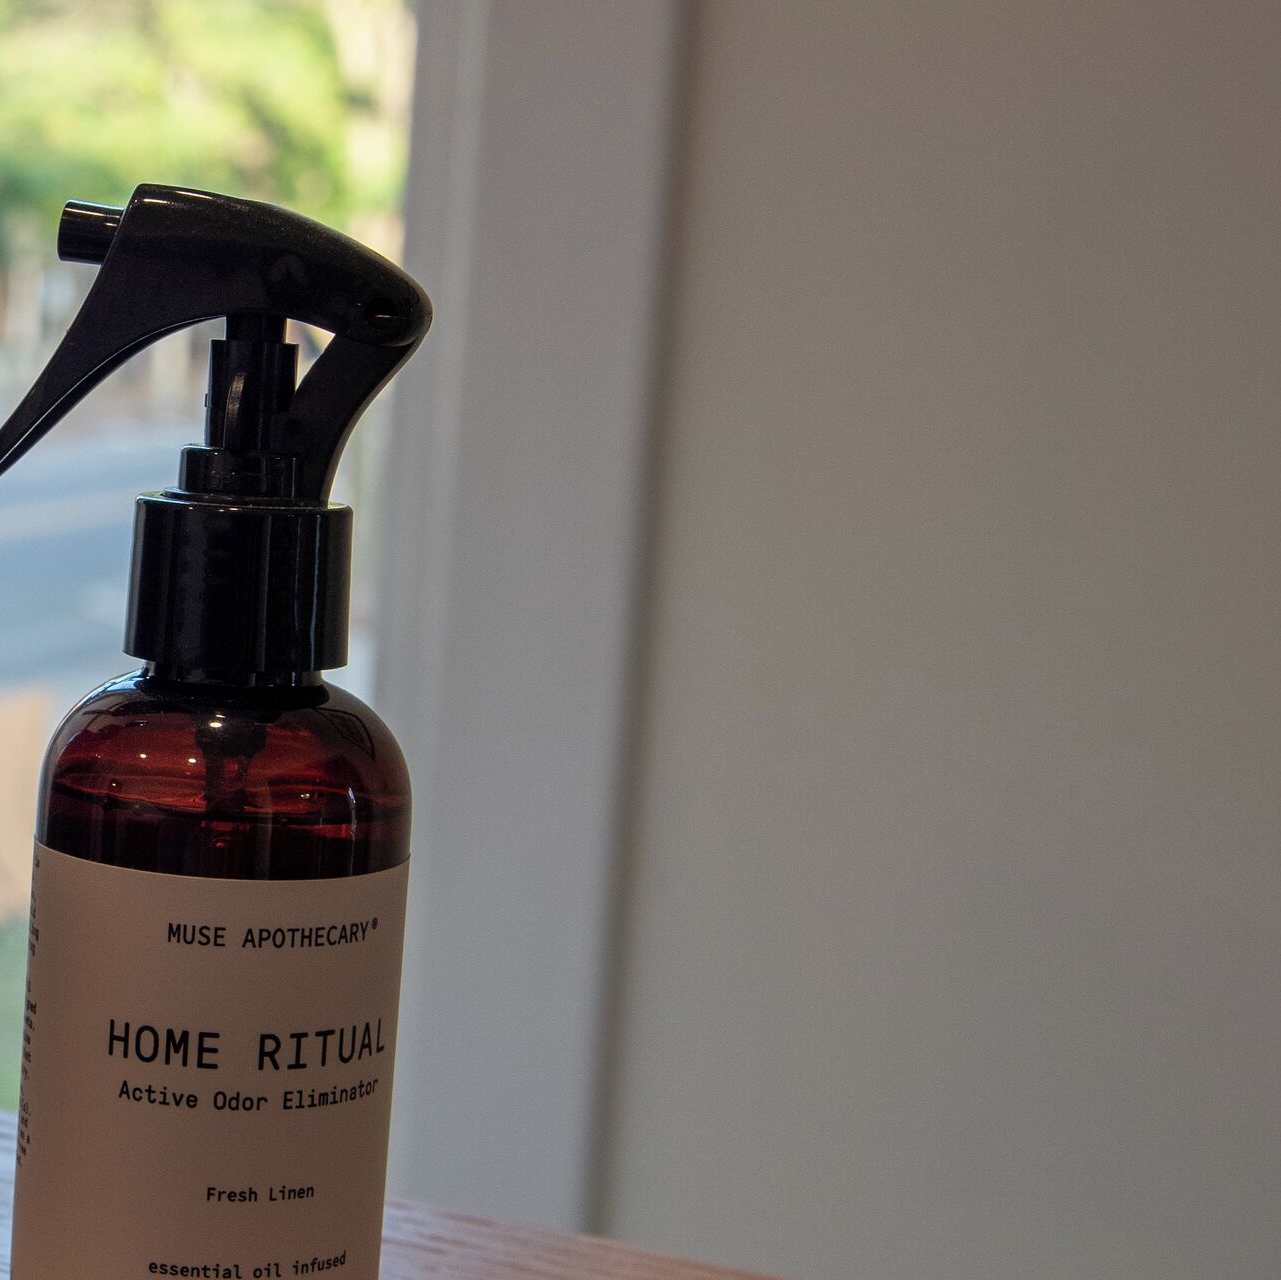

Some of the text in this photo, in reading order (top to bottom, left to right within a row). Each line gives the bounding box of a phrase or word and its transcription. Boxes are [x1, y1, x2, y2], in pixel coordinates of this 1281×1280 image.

[168, 923, 226, 947] MUSE
[108, 1018, 384, 1070] HOME RITUAL
[119, 1078, 378, 1111] Active Odor Eliminator
[206, 1185, 315, 1202] Fresh Linen
[148, 1250, 347, 1279] essential oil infused
